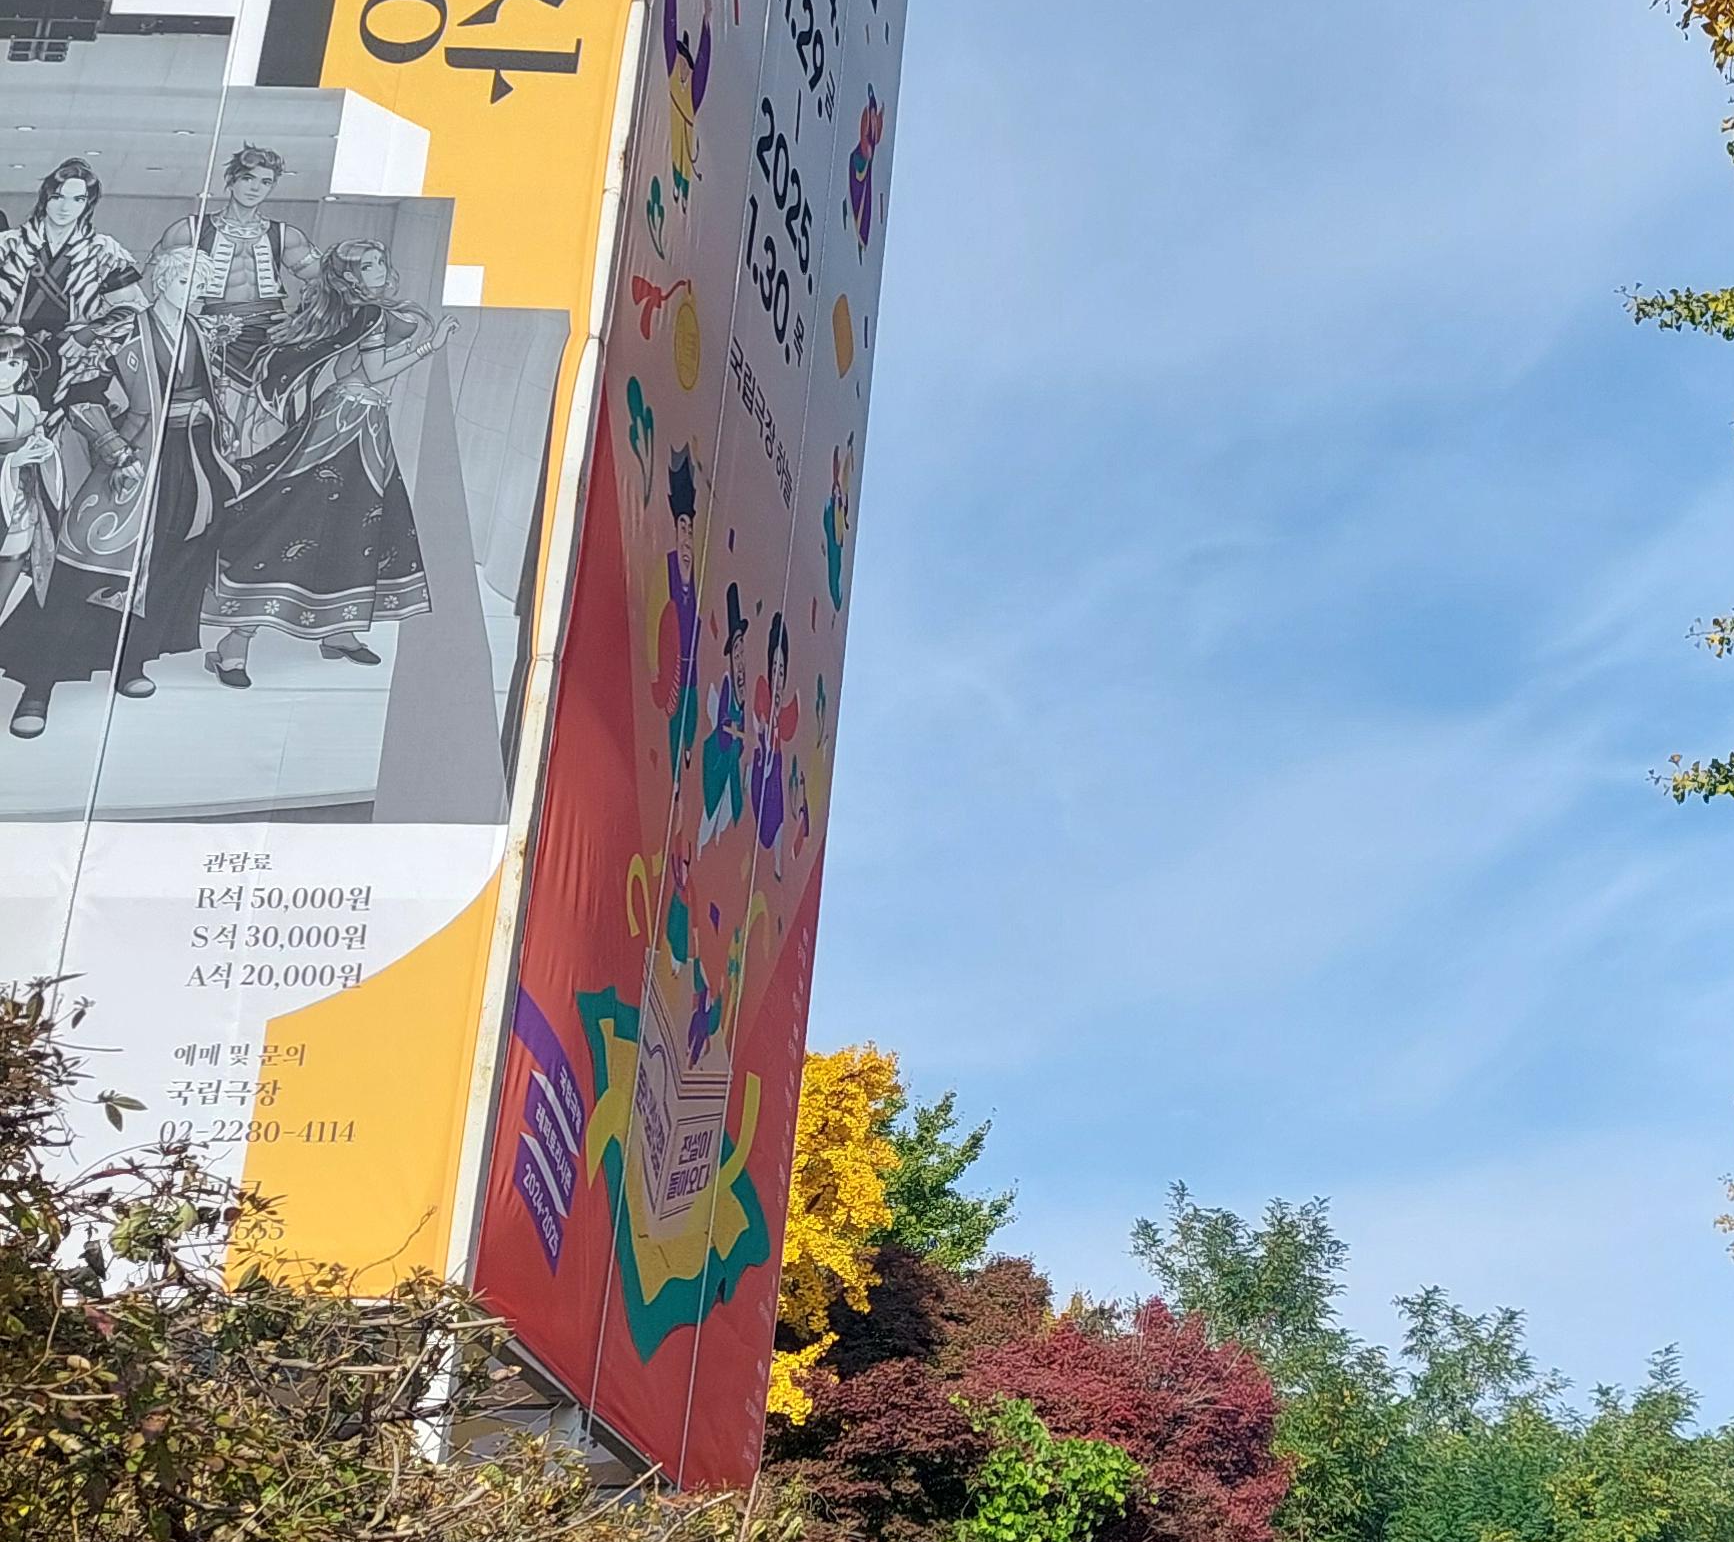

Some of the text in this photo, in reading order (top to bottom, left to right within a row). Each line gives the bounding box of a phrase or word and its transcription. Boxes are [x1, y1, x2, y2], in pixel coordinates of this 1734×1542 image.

[760, 95, 814, 296] 2025.
[203, 852, 273, 873] 관람료
[196, 886, 373, 913] R석 50,000원
[245, 924, 367, 952] 30,000원
[186, 962, 363, 991] A석 20,000원
[174, 1043, 306, 1067] 예매 및 문의
[166, 1079, 282, 1107] 국립극장
[159, 1120, 356, 1145] 02-2280-4114
